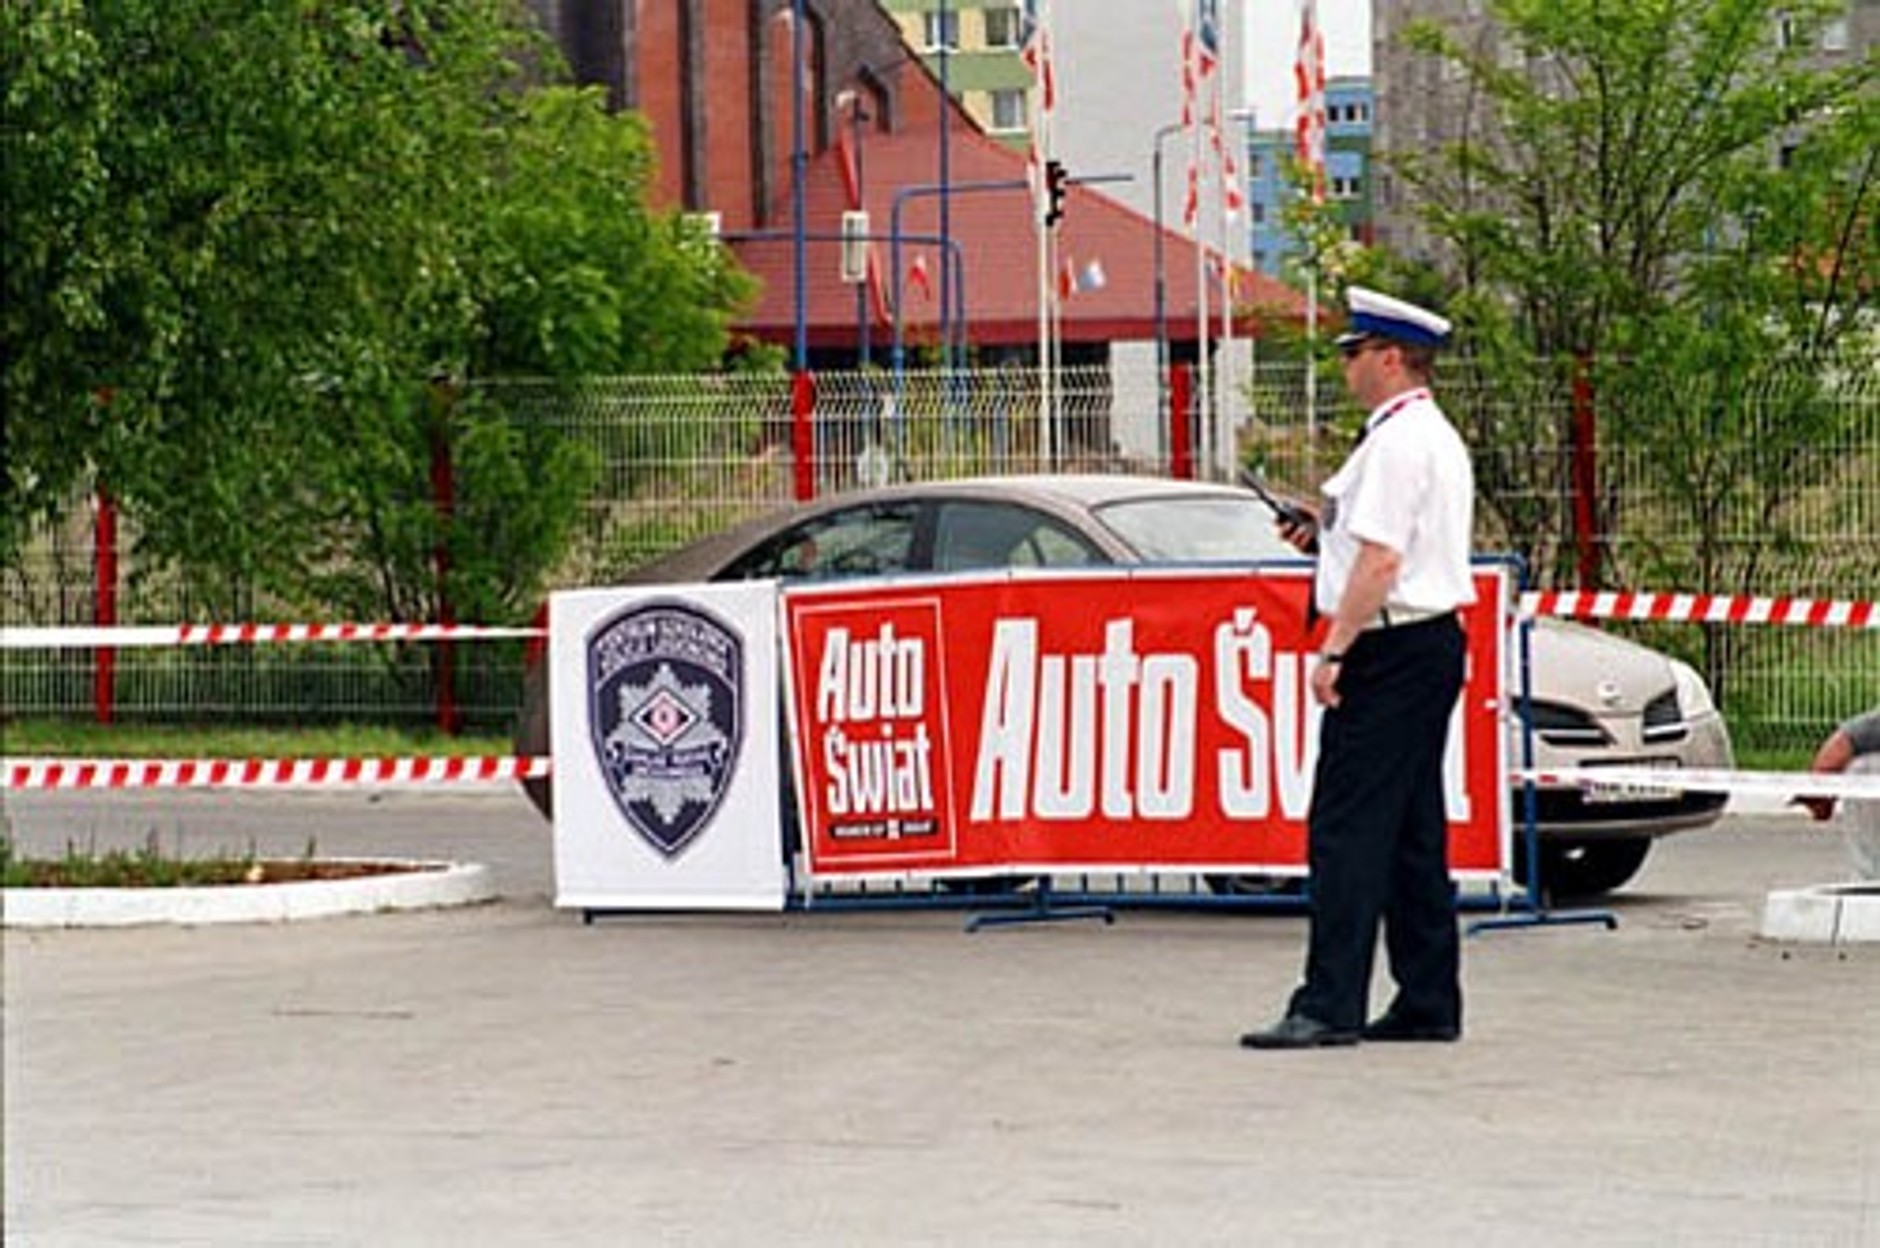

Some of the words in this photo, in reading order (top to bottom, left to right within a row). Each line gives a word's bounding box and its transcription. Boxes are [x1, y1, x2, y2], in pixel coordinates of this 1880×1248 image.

[817, 622, 924, 723] Auto
[969, 616, 1198, 821] Auto
[823, 722, 933, 814] Świat
